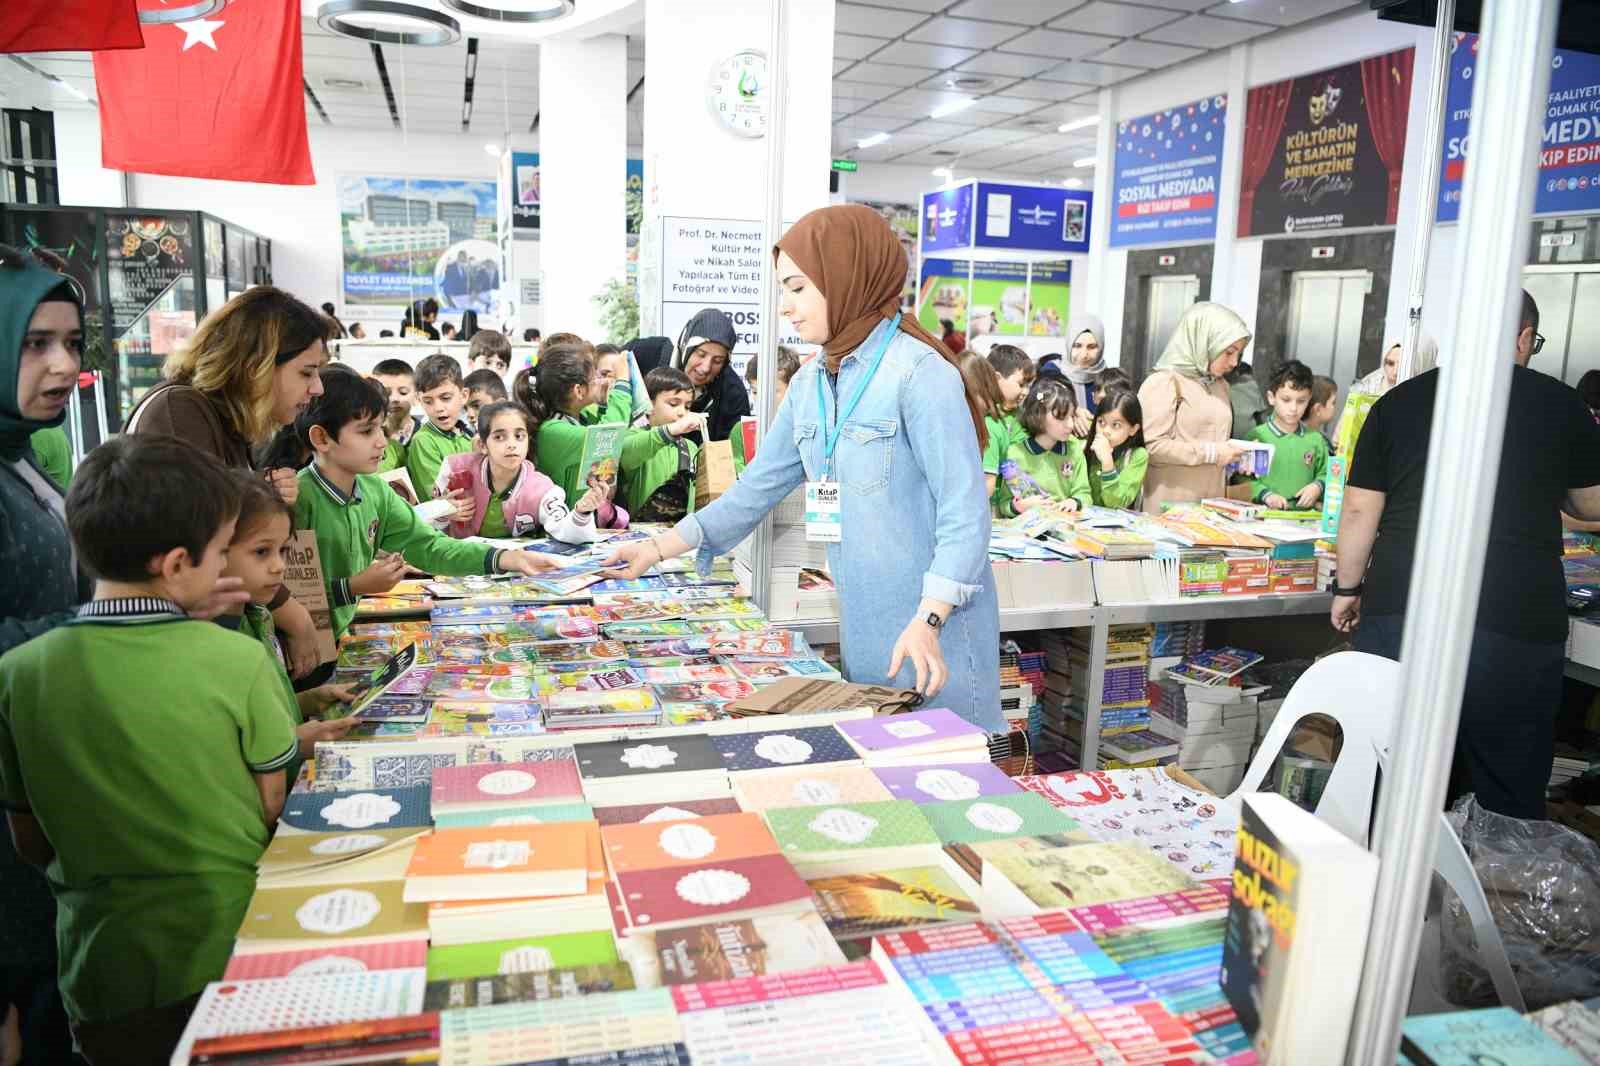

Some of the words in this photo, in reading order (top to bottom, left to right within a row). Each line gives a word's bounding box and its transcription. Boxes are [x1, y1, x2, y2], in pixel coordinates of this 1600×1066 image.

[1548, 102, 1587, 118] OLMAK
[1286, 121, 1359, 151] KÜLTÜRÜN
[1286, 150, 1302, 164] VE
[1304, 142, 1357, 162] SANATIN
[1284, 157, 1355, 179] MERKEZİNE
[1118, 183, 1158, 204] SOSYAL
[1158, 175, 1215, 199] MEDYADA
[679, 228, 702, 239] Prof.
[705, 230, 718, 239] Dr.
[711, 243, 741, 254] Kültür
[694, 258, 705, 266] ve
[707, 257, 735, 267] Nikah
[346, 275, 381, 285] DEVLET
[679, 270, 725, 281] Yapılacak
[728, 271, 749, 281] Tüm
[672, 283, 715, 295] Fotoğraf
[718, 286, 729, 294] ve
[731, 284, 760, 295] Video
